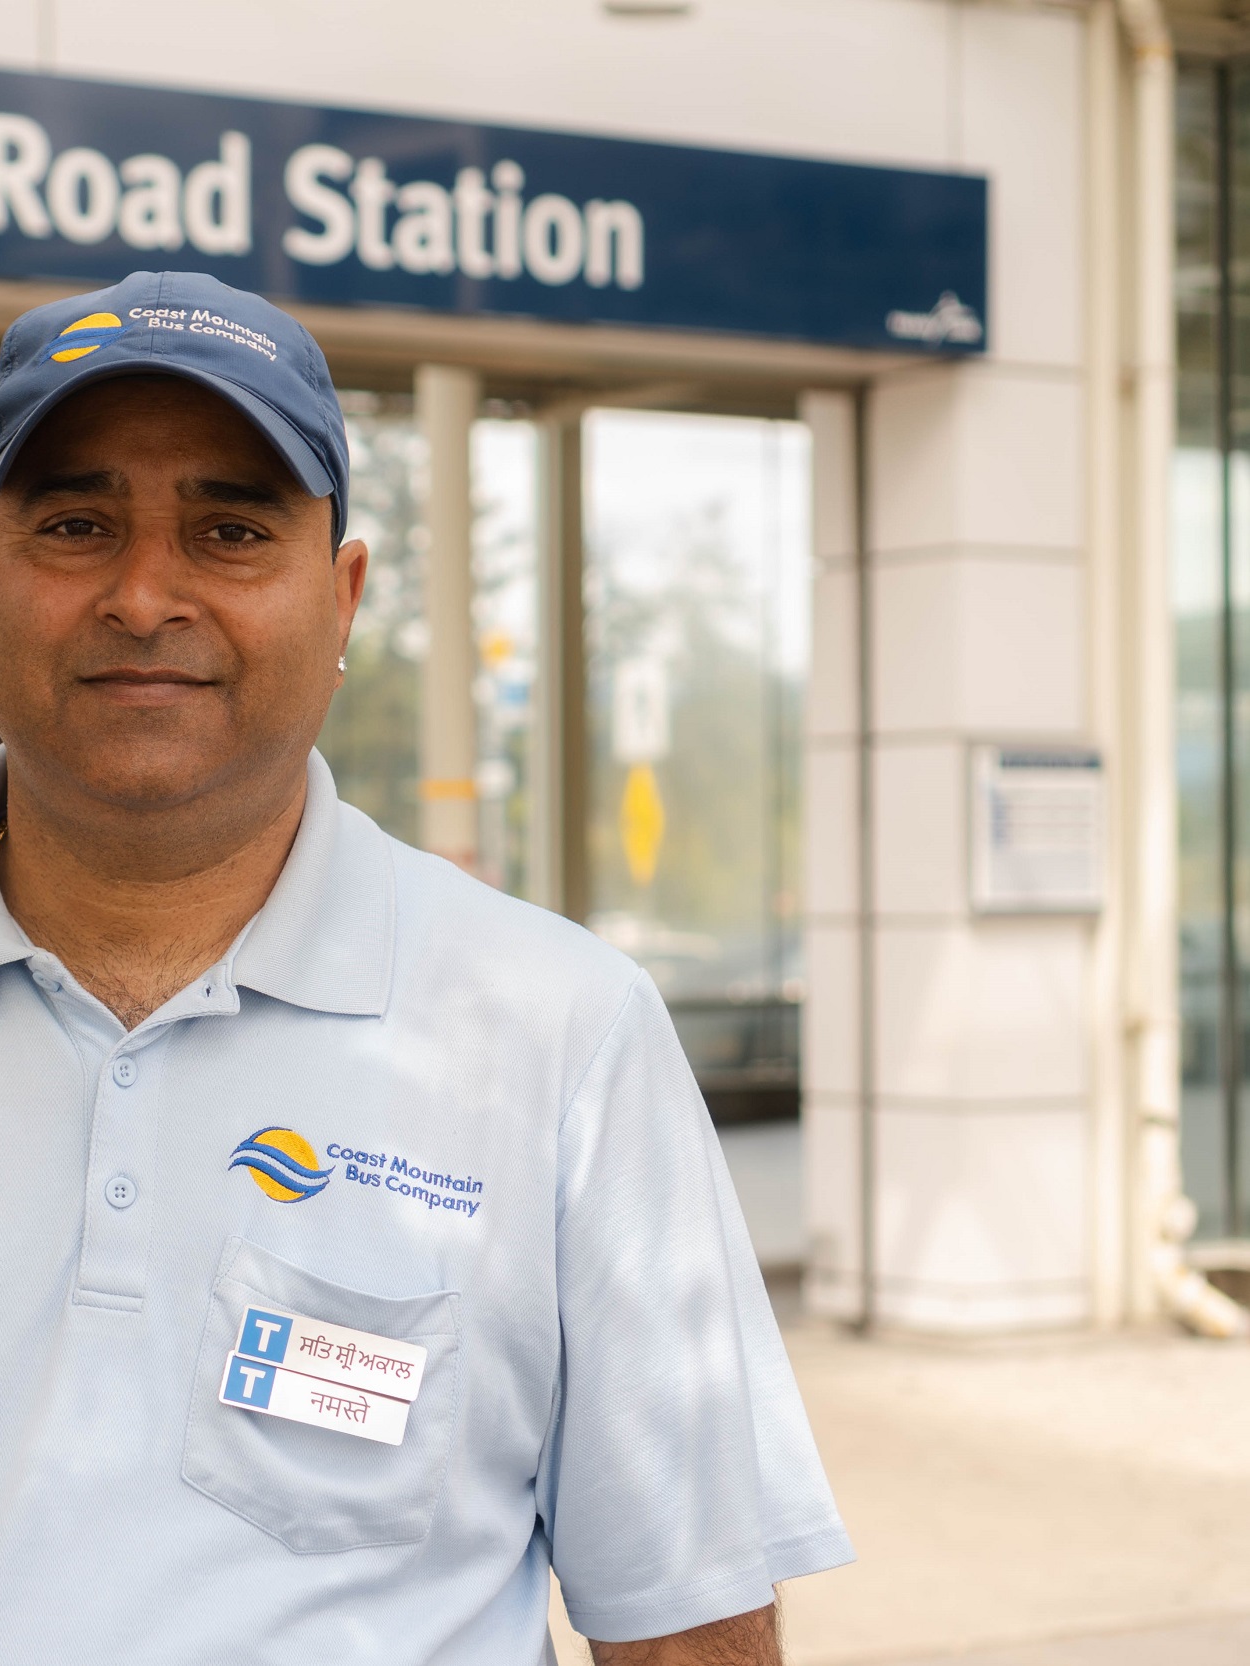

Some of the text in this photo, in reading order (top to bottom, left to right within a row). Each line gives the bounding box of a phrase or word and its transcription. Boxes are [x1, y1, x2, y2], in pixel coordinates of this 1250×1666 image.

[283, 143, 644, 291] Station
[129, 307, 277, 351] Coast Mountain
[148, 317, 277, 362] Bus Company
[326, 1143, 483, 1193] Coast Mountain
[345, 1163, 480, 1218] Bus Company
[255, 1319, 282, 1353] T
[299, 1335, 334, 1359] ਸਤਿ
[358, 1350, 414, 1379] ਅਕਾਲ
[239, 1365, 266, 1399] T
[310, 1391, 371, 1424] नमस्ते
